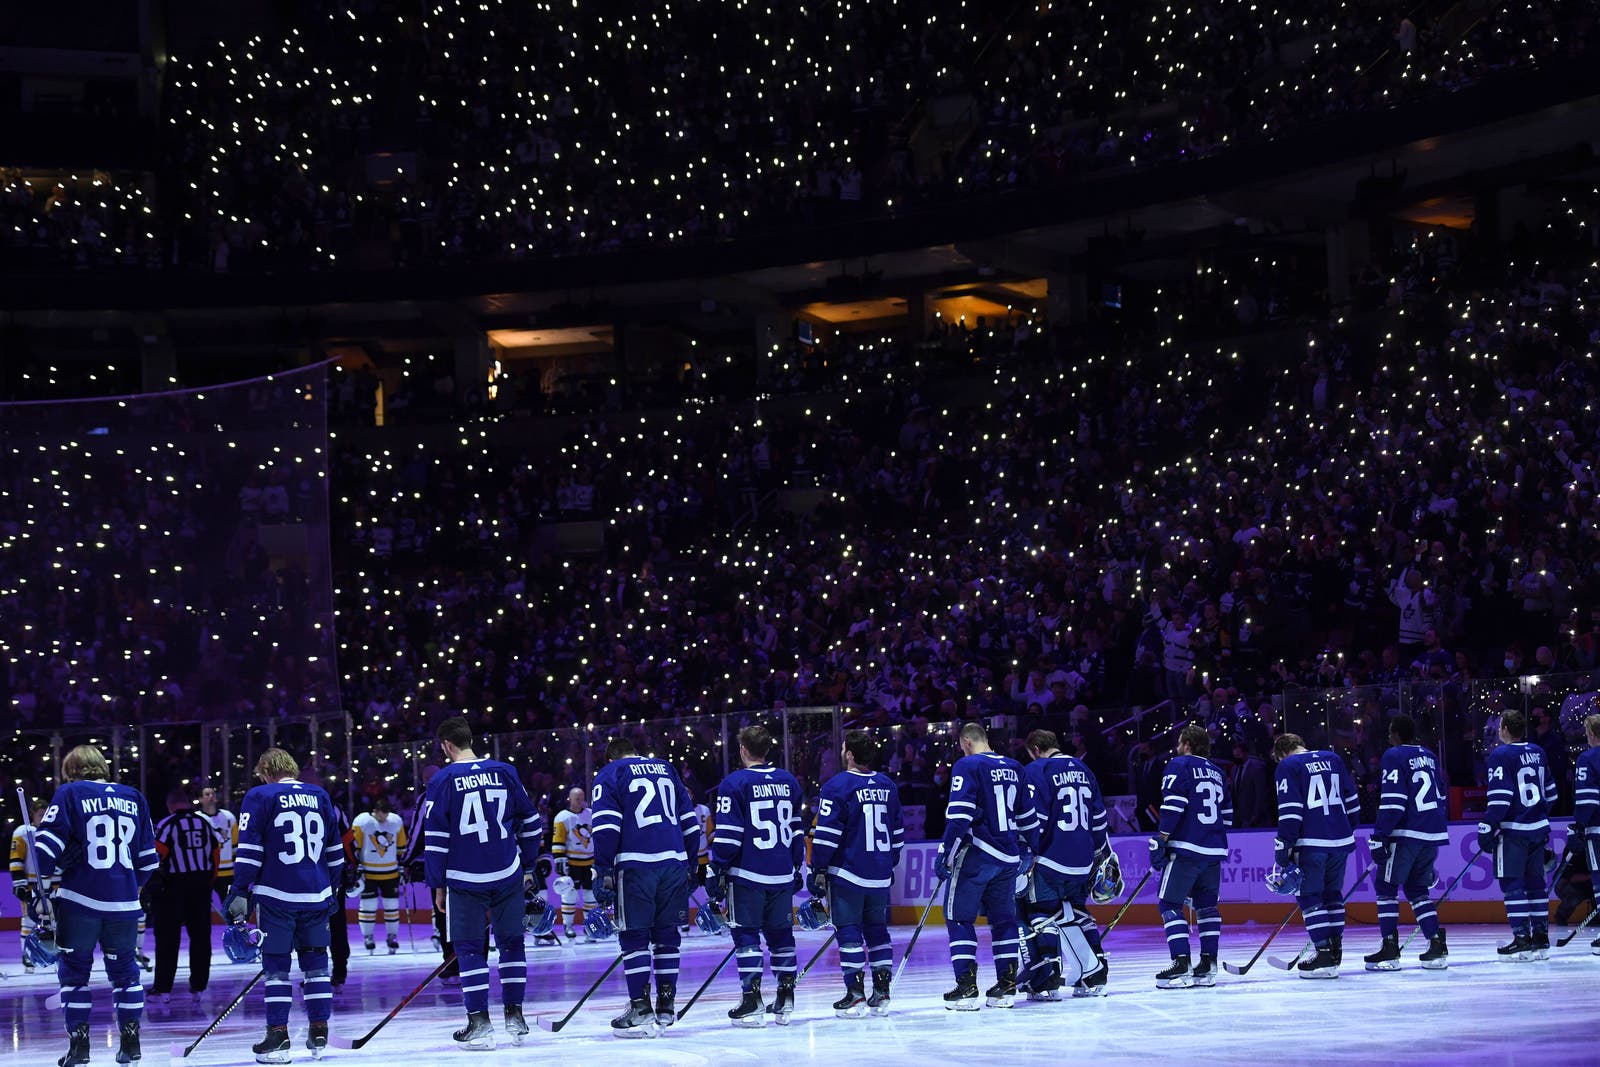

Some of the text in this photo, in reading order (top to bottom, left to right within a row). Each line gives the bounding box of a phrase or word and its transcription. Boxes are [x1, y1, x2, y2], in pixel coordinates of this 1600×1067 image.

[629, 764, 669, 776] RITCHIE
[1305, 760, 1332, 774] RIELLY
[1575, 766, 1588, 781] 5
[454, 772, 503, 792] ENGVALL
[752, 783, 791, 799] BUNTING
[950, 775, 964, 793] 9
[81, 796, 138, 817] NYLANDER
[279, 794, 319, 810] SANDIN
[628, 777, 678, 829] 20
[819, 797, 834, 817] 5
[1056, 786, 1093, 832] 36
[40, 804, 60, 823] 8
[459, 788, 508, 844] 47
[749, 799, 794, 850] 58
[862, 803, 891, 852] 15
[86, 813, 137, 870] 88
[184, 830, 203, 849] 16
[274, 810, 325, 865] 38
